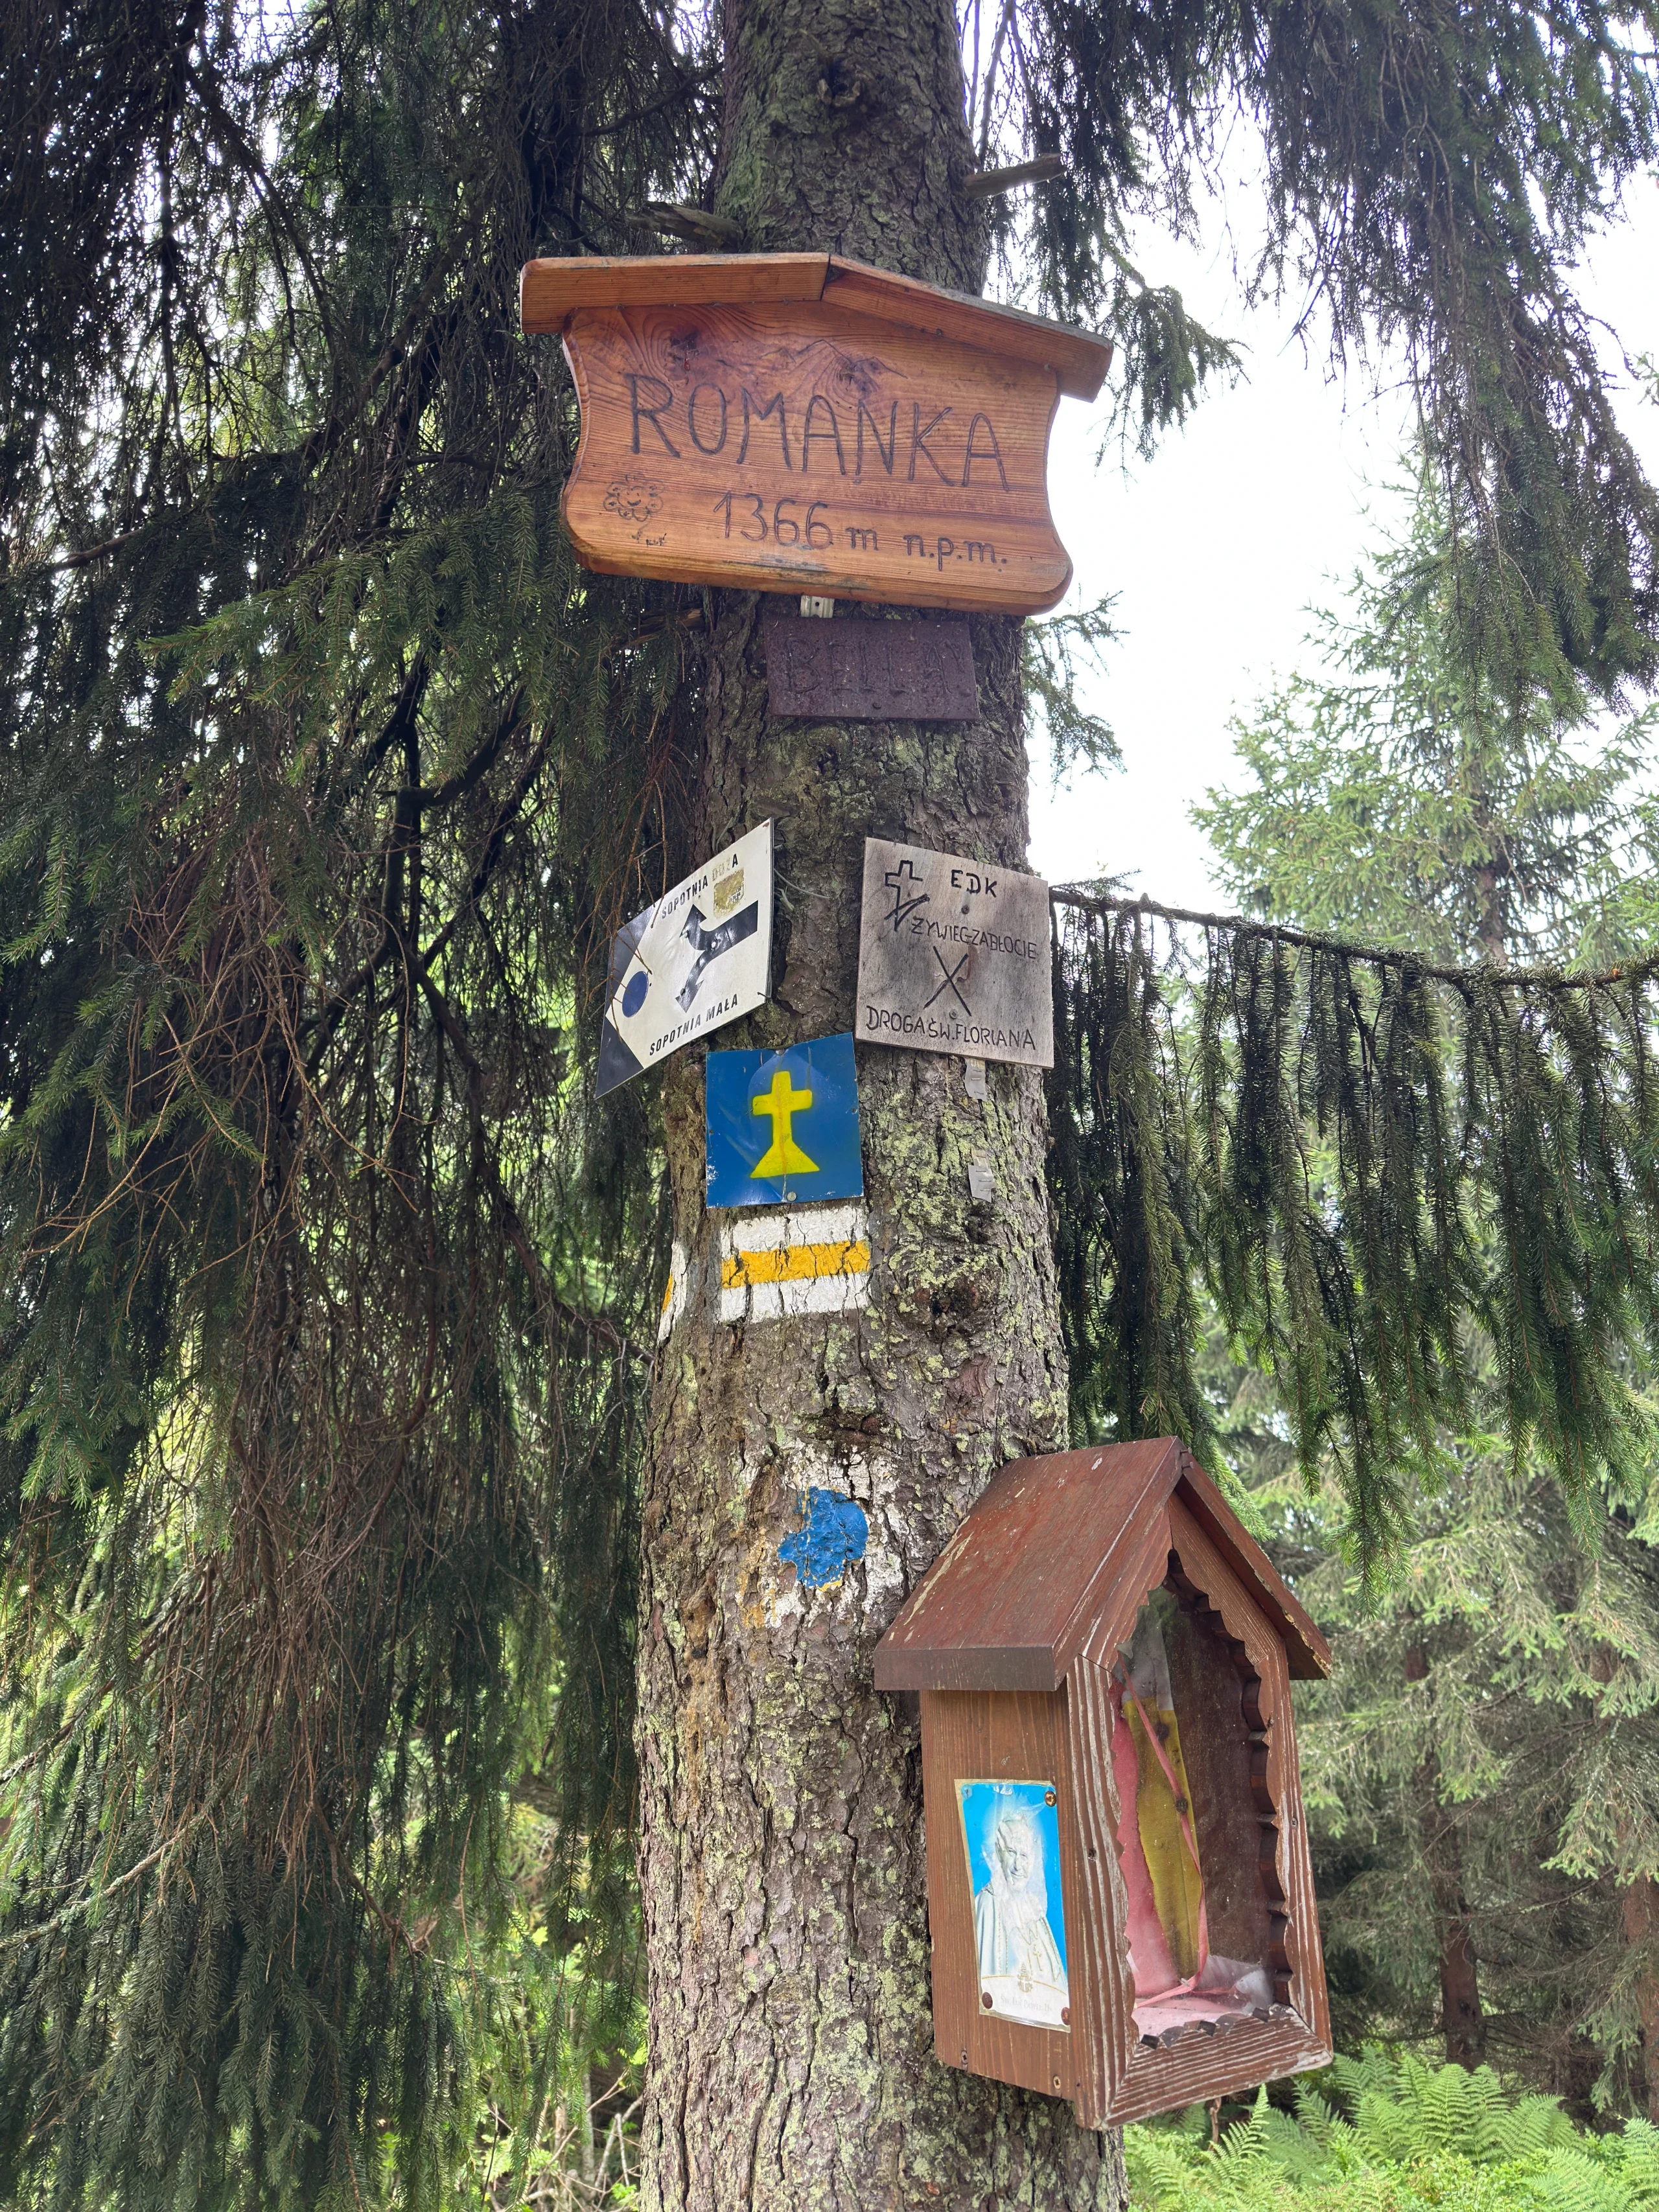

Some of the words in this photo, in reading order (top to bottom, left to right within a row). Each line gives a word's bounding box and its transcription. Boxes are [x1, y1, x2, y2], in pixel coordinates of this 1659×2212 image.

[625, 373, 1009, 492] ROMANKA
[713, 491, 833, 551] 1366
[845, 526, 880, 551] m
[903, 534, 1008, 573] n.p.m.
[662, 874, 708, 919] SOPOTNIA
[951, 869, 998, 898] EDK
[649, 1014, 701, 1056] SOPOTNIA
[706, 993, 738, 1023] MAŁA
[866, 1005, 925, 1034] DROGA
[956, 1023, 1036, 1051] FLORIANA
